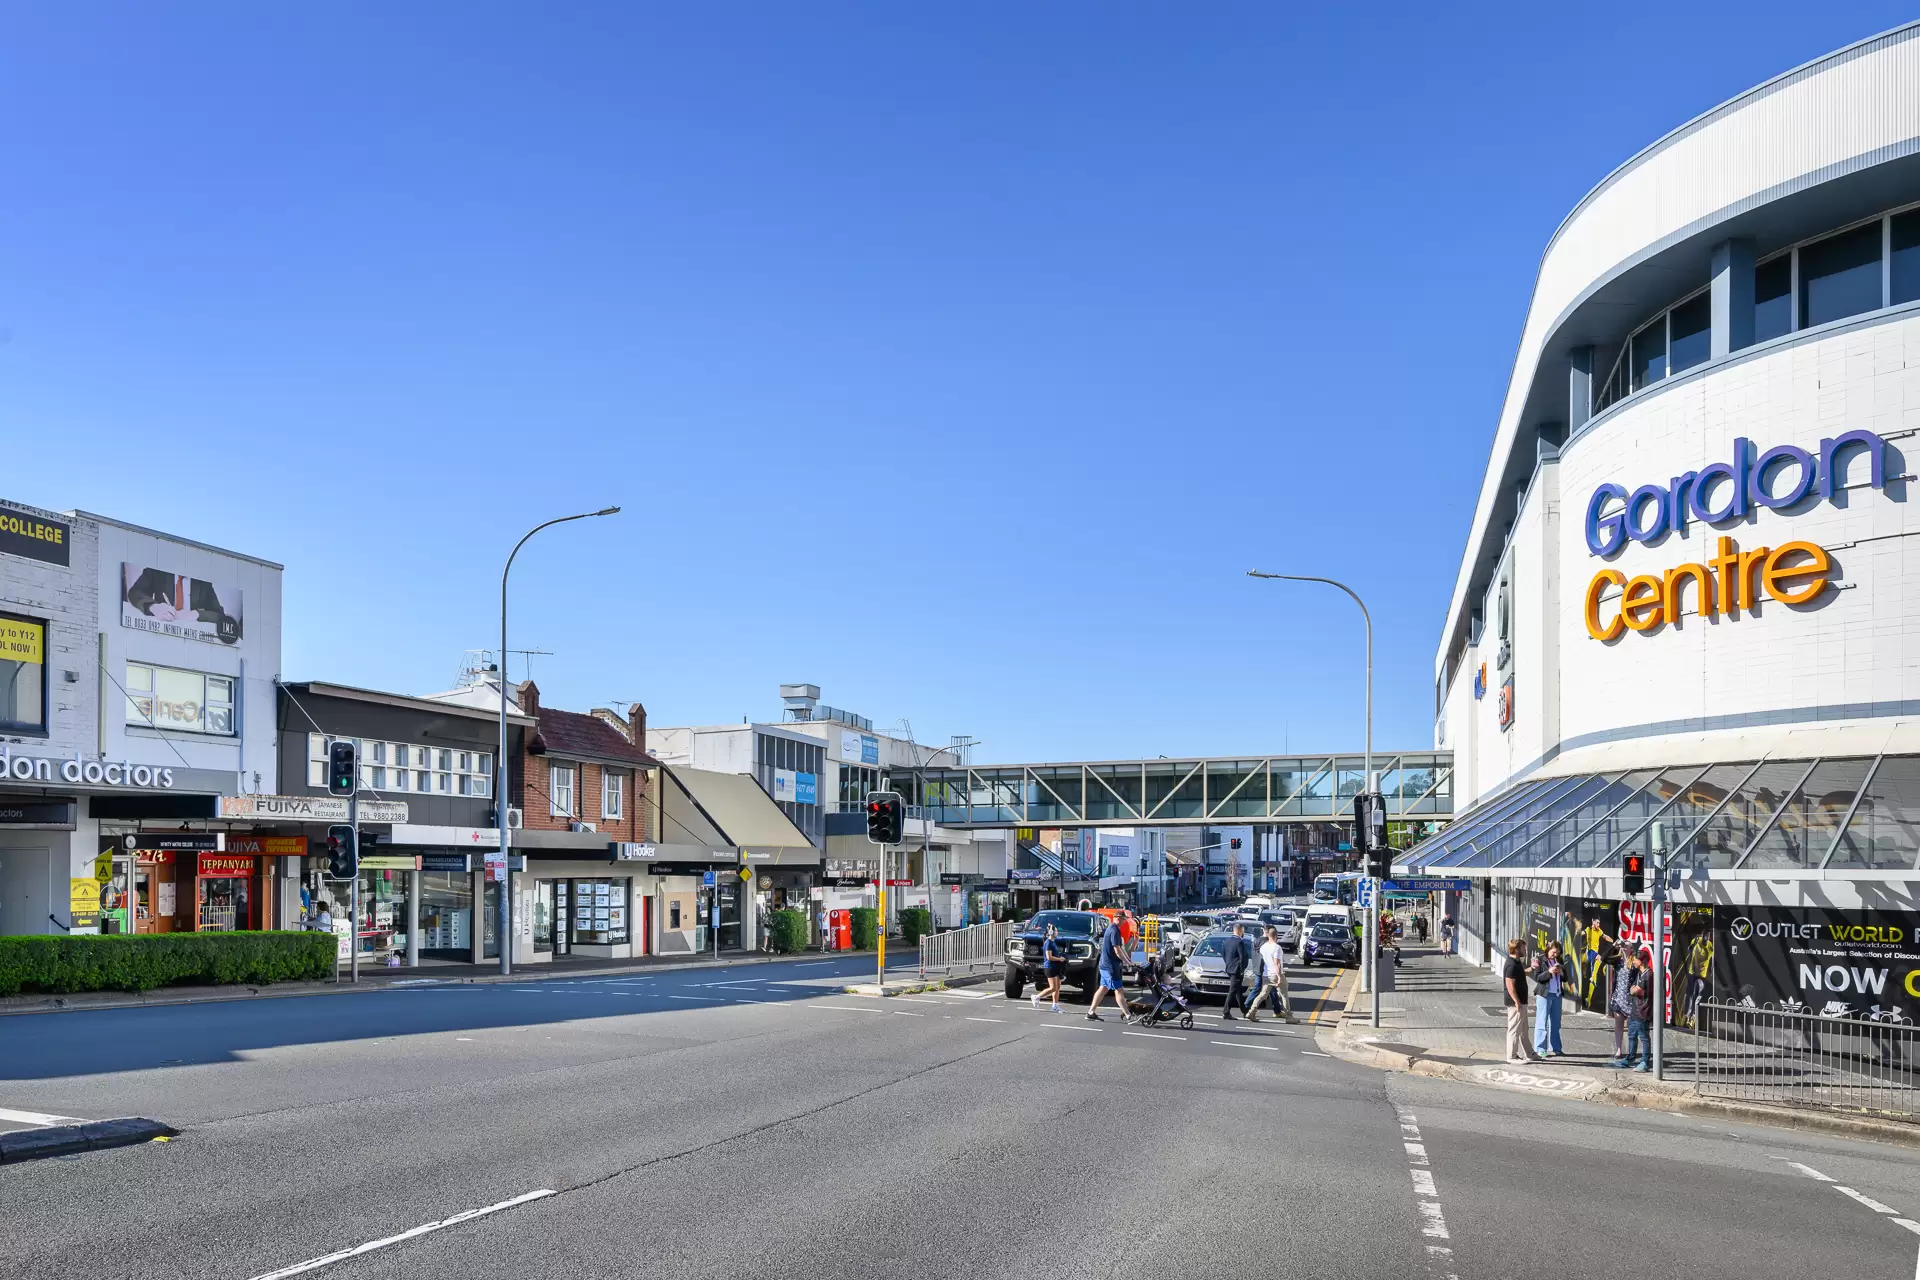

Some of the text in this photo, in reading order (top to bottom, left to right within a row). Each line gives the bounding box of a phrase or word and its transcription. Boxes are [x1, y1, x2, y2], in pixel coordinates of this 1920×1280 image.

[1585, 430, 1888, 555] Gordon
[0, 515, 62, 544] COLLEGE
[1585, 536, 1831, 641] Centre
[8, 628, 17, 637] to
[20, 629, 35, 641] Y12
[164, 624, 182, 636] INFINITY
[184, 628, 197, 639] MATHS
[11, 642, 31, 654] NOW
[60, 751, 173, 788] doctors
[256, 800, 312, 813] FUJIYA
[314, 810, 346, 818] RESTAURANT
[374, 812, 390, 821] 9880
[390, 813, 406, 822] 2388
[227, 841, 260, 853] UJIYA
[266, 845, 303, 853] TEPPANYAKI
[623, 844, 655, 859] LJ Hooker
[202, 859, 254, 869] TEPPANYAKI
[1396, 880, 1455, 889] THE EMPORIUM
[612, 930, 626, 938] Hooker
[1756, 922, 1822, 940] OUTLET
[1828, 924, 1904, 943] WORLD
[1789, 947, 1822, 956] Australia's
[1822, 949, 1848, 958] Largest
[1849, 950, 1882, 959] Selection
[1884, 952, 1893, 960] of
[1799, 963, 1889, 995] NOW
[1827, 1001, 1849, 1011] NIKE
